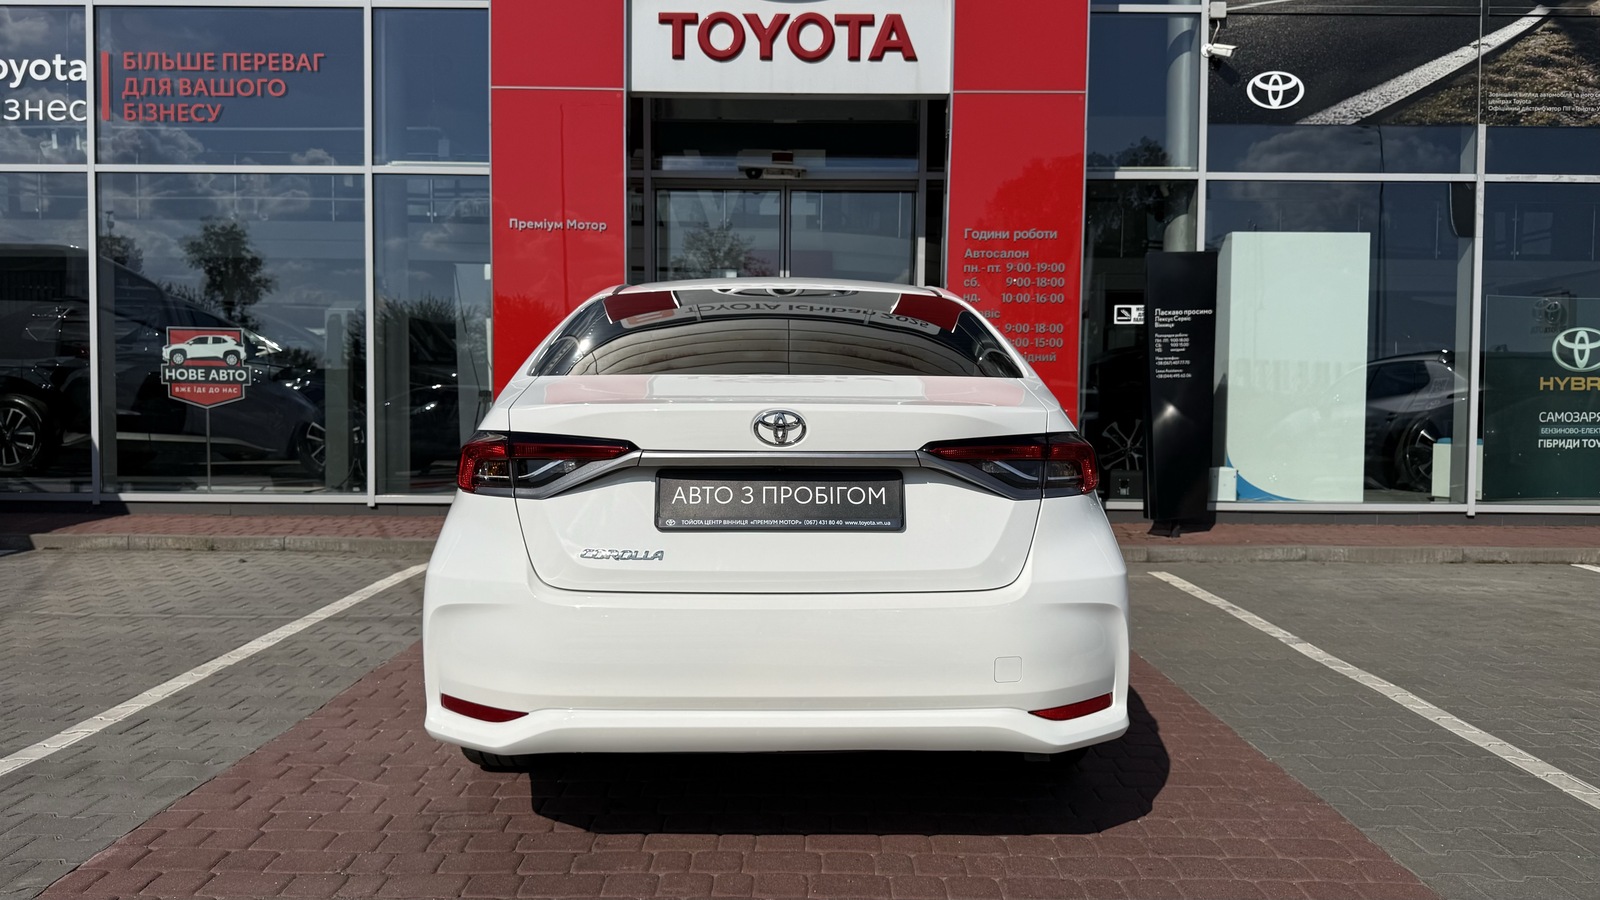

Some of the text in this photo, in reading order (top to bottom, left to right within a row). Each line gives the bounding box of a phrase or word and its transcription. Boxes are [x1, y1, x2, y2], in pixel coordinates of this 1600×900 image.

[658, 11, 918, 62] TOYOTA
[122, 52, 325, 72] БІЛЬШЕ ПЕРЕВАГ
[122, 77, 286, 99] ДЛЯ ВАШОГО
[123, 103, 222, 122] БІЗНЕСУ
[509, 218, 607, 232] Преміум Мотор
[964, 228, 1058, 241] Години роботи
[964, 248, 1029, 259] Автосалон
[963, 277, 980, 287] сб.
[1154, 308, 1183, 316] Ласкаво
[1022, 352, 1057, 362] ідний
[165, 368, 247, 381] НОВЕ АВТО
[1539, 376, 1600, 391] HYBR
[1540, 427, 1600, 435] БЕНЗИНОВО-ЕЛЕК
[1538, 438, 1580, 450] ГІБРИДИ
[672, 486, 887, 505] АВТО З ПРОБІГОМ
[844, 519, 891, 527] www.toyota.vn.ua
